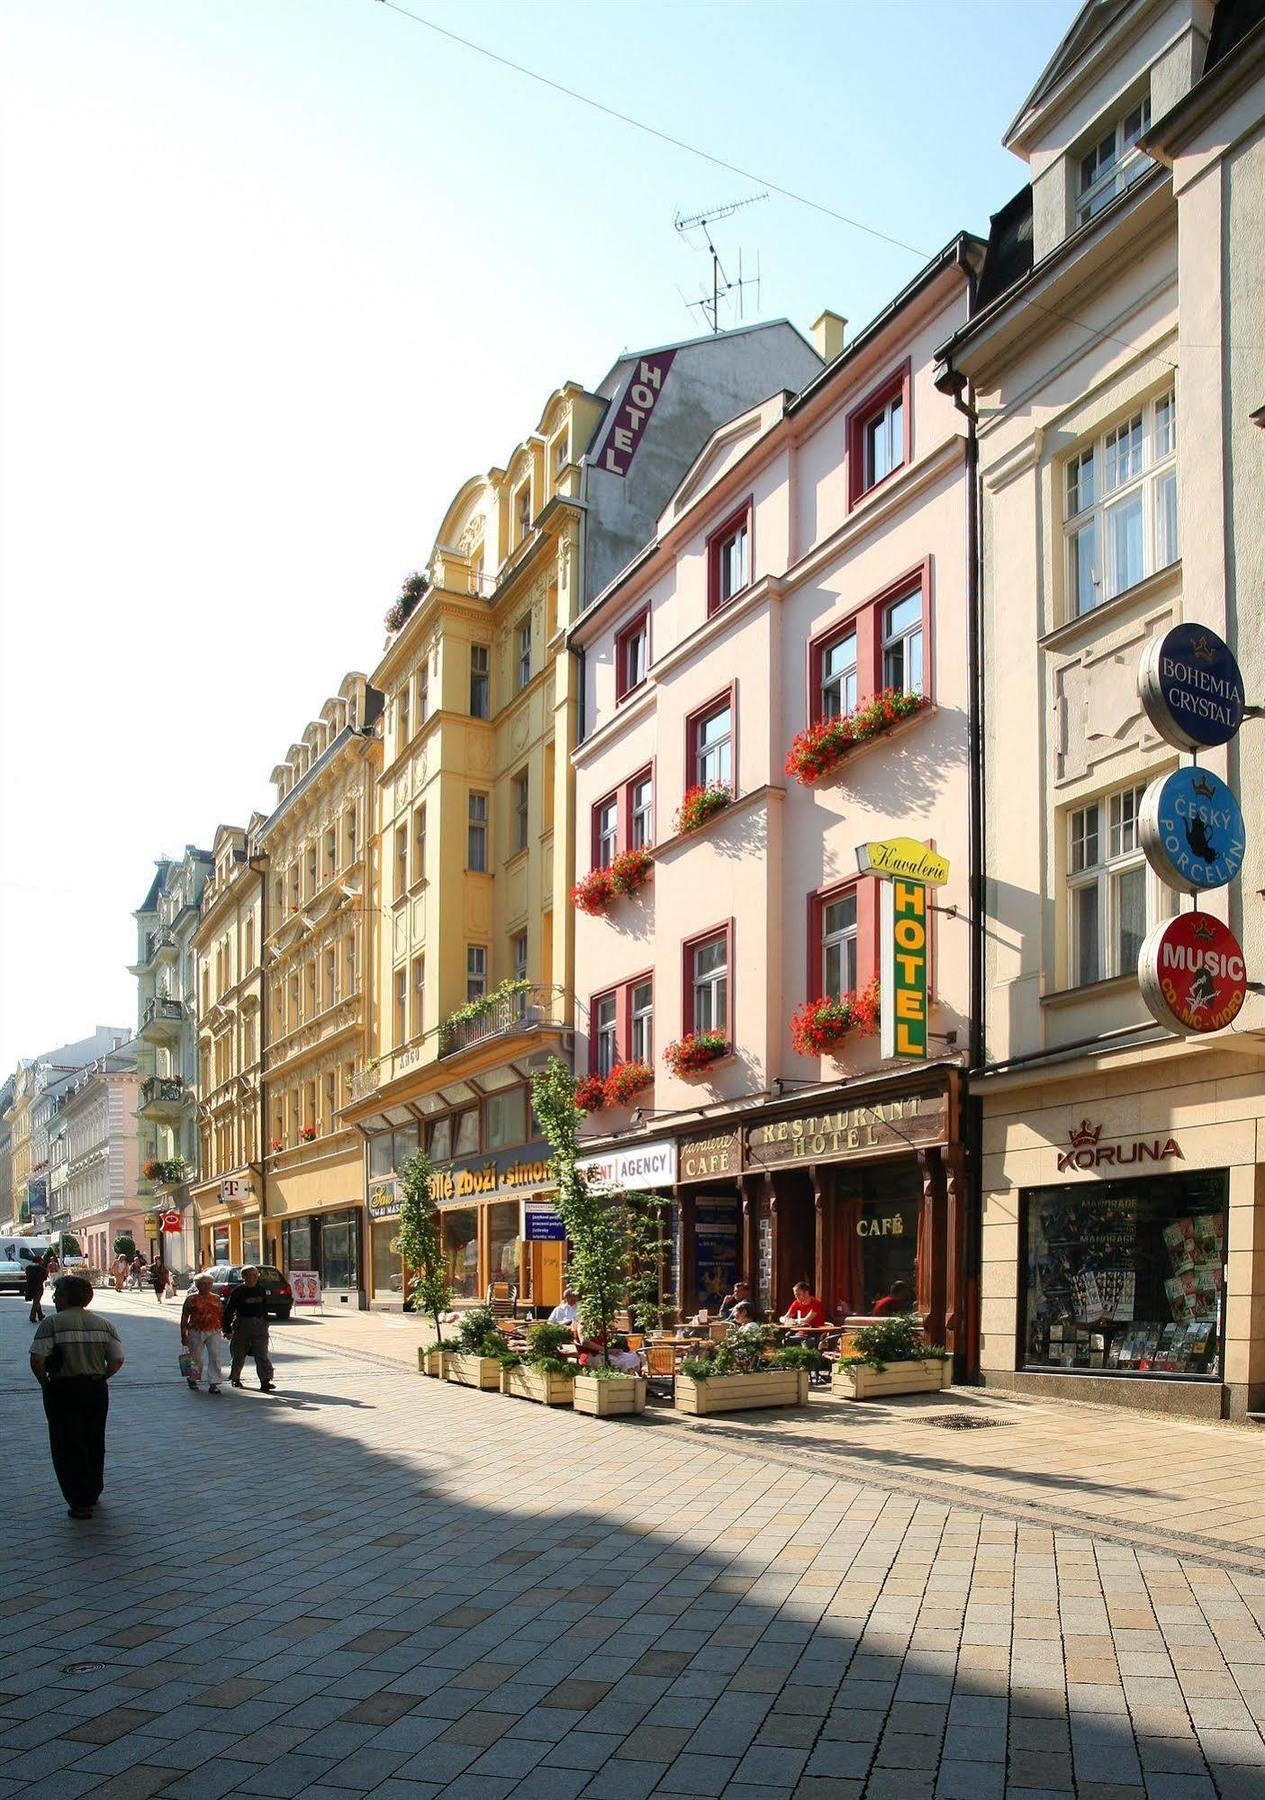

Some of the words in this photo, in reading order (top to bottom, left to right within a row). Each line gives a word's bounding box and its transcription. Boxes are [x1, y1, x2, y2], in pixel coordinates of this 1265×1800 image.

[606, 361, 661, 474] HOTEL
[1163, 657, 1241, 704] BOHEMIA
[1169, 688, 1236, 727] CRYSTAL
[1175, 793, 1231, 830] ČESKÝ
[873, 844, 945, 880] Kavalerie
[1161, 819, 1244, 883] PORCELÁN
[895, 883, 925, 1055] HOTEL
[1163, 943, 1243, 982] MUSIC
[1162, 978, 1176, 1004] CD
[1211, 990, 1243, 1029] VIDEO
[763, 1096, 921, 1144] RESTAURANT
[792, 1125, 880, 1157] HOTEL
[1057, 1138, 1185, 1173] KORUNA
[456, 1161, 497, 1195] zboží
[621, 1154, 667, 1177] AGENCY
[686, 1150, 729, 1176] CAFÉ
[225, 1181, 238, 1196] T
[856, 1213, 904, 1237] CAFÉ
